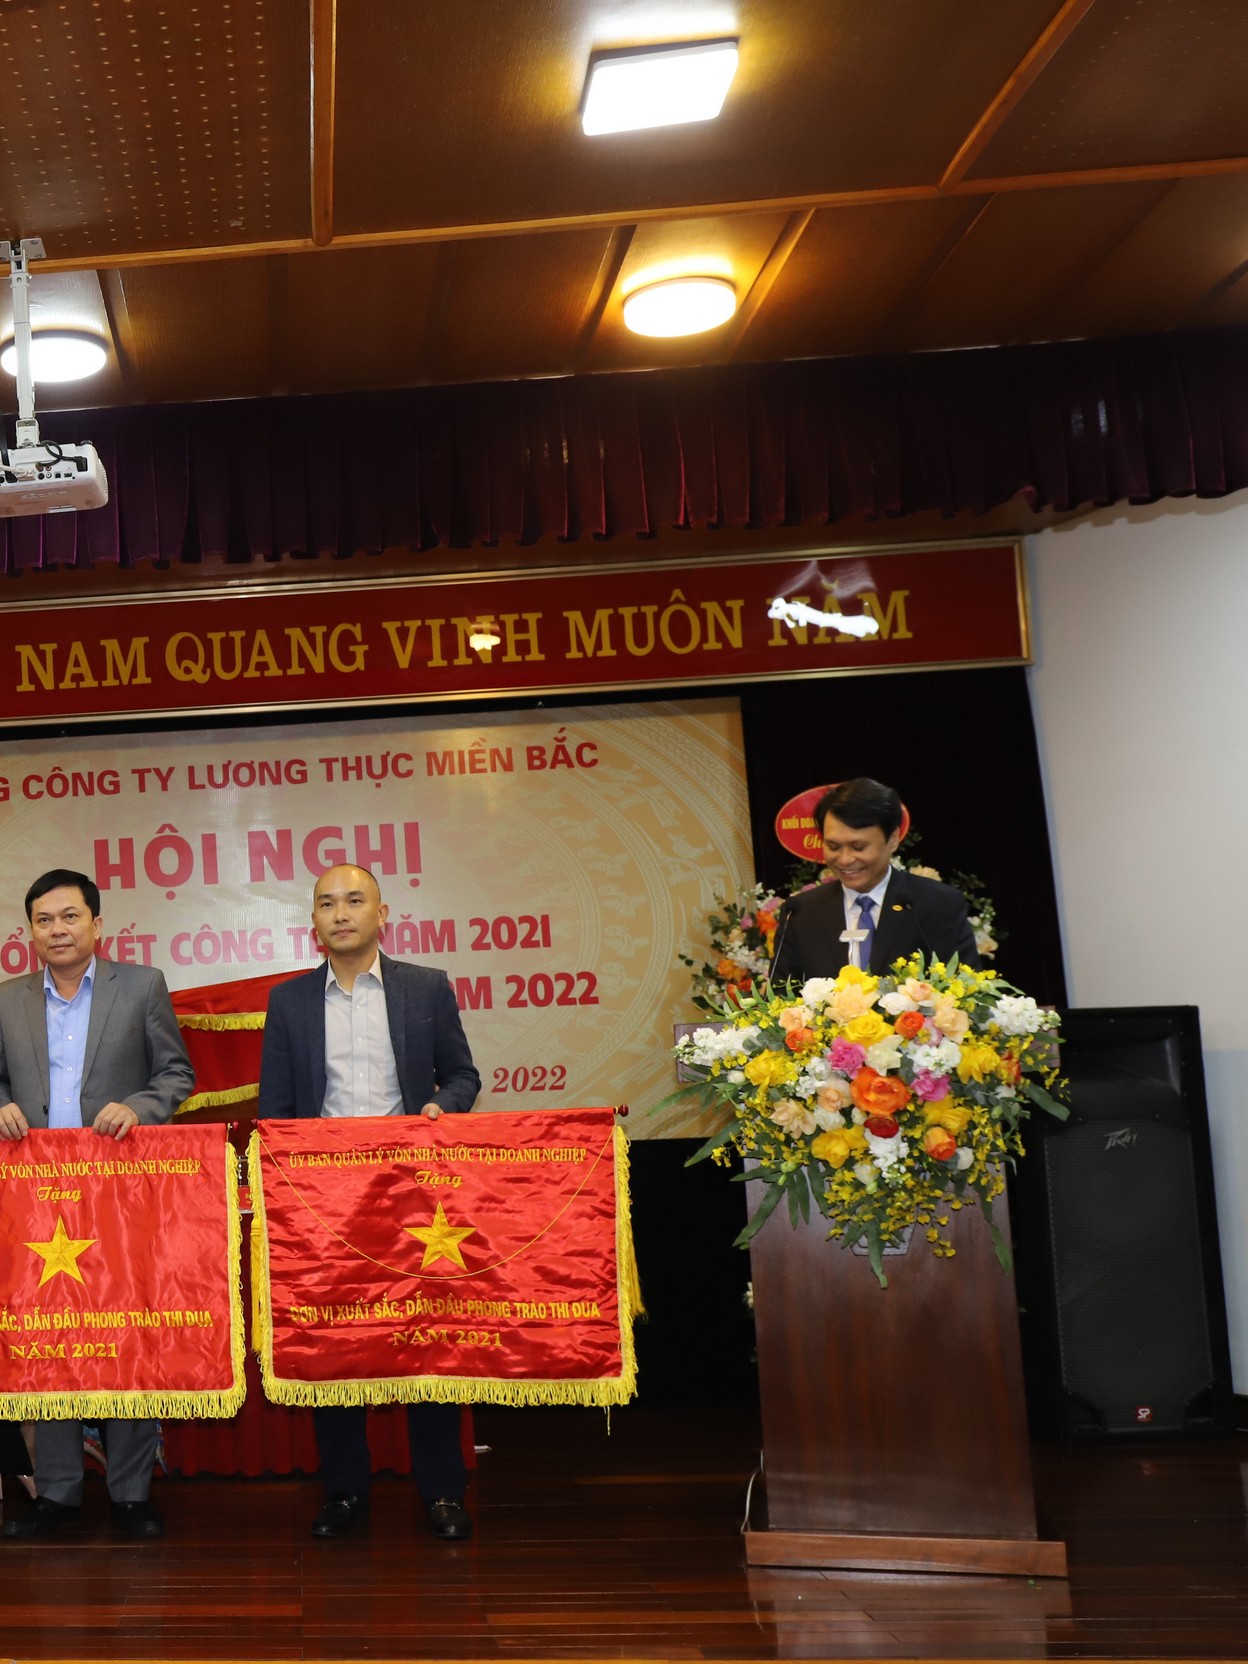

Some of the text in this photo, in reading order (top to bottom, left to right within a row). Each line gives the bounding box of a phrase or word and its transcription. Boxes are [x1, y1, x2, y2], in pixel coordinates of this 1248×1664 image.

[15, 636, 151, 692] NAM
[165, 622, 369, 684] QUANG
[382, 612, 546, 669] VINH
[563, 588, 746, 659] MUÔN
[22, 767, 121, 800] CÔNG
[131, 766, 176, 793] TY
[188, 759, 308, 791] LƯƠNG
[319, 750, 414, 789] THỰC
[426, 737, 515, 777] MIỀN
[526, 727, 600, 770] BẮC
[93, 822, 423, 901] HỘI NGHỊ
[96, 922, 157, 967] KẾT
[170, 923, 274, 966] CÔNG
[378, 914, 457, 955] NĂM
[505, 971, 599, 1009] 2022
[491, 1064, 567, 1093] 2022
[61, 1158, 94, 1177] NƯỚC
[95, 1160, 116, 1178] TẠI
[117, 1160, 157, 1175] DOANH
[159, 1157, 201, 1176] NGHIỆP
[307, 1153, 331, 1167] BAN
[333, 1148, 367, 1168] QUẢN
[369, 1147, 385, 1165] LÝ
[441, 1144, 475, 1162] NƯỚC
[477, 1148, 497, 1165] TẠI
[499, 1148, 541, 1163] DOANH
[542, 1146, 587, 1165] NGHIỆP
[414, 1170, 463, 1188] Tặng
[36, 1186, 82, 1203] Tặng
[23, 1305, 52, 1331] DẪN
[53, 1306, 81, 1330] ĐẦU
[83, 1311, 127, 1329] PHONG
[128, 1307, 161, 1328] TRÀO
[162, 1310, 184, 1327] THI
[185, 1310, 214, 1328] ĐUA
[289, 1305, 318, 1323] ĐƠN
[320, 1305, 334, 1326] VỊ
[336, 1297, 371, 1321] XUẤT
[405, 1290, 434, 1316] DẪN
[436, 1292, 464, 1315] ĐẦU
[467, 1299, 512, 1318] PHONG
[514, 1299, 547, 1319] TRÀO
[549, 1302, 570, 1318] THI
[572, 1301, 601, 1318] ĐUA
[9, 1341, 118, 1360] NĂM 2021
[455, 1329, 503, 1347] 2021
